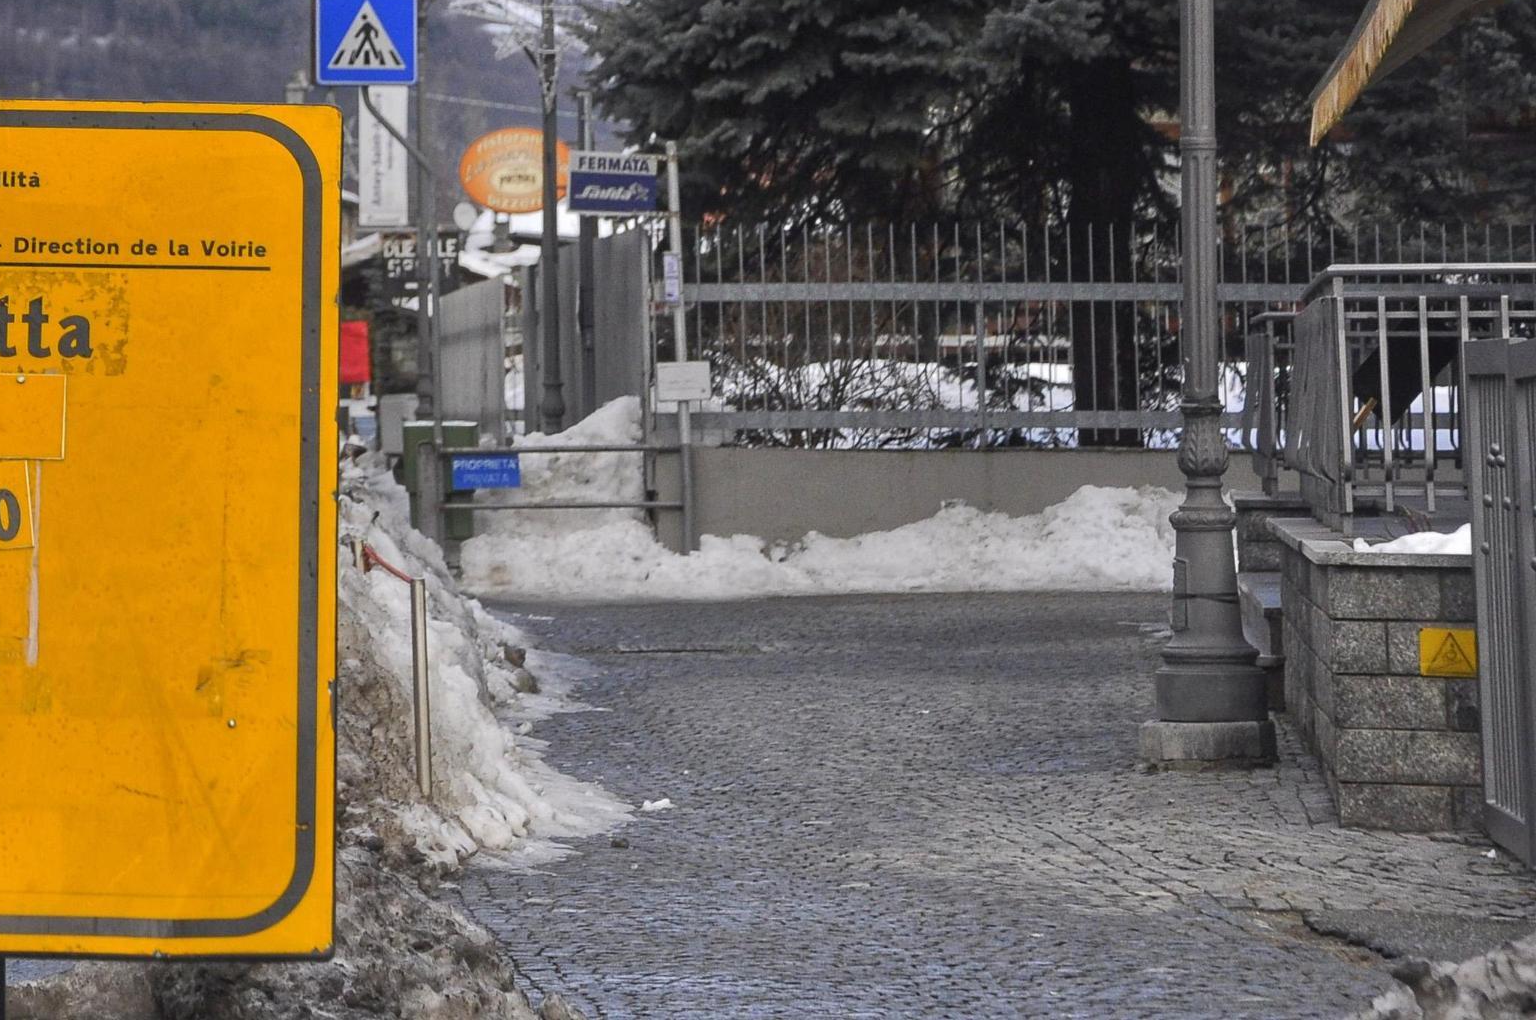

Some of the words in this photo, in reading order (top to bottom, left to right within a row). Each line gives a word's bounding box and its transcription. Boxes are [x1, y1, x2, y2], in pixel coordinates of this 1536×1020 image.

[578, 156, 651, 173] FERMATA
[15, 237, 119, 254] Direction
[131, 240, 157, 255] de
[169, 240, 189, 256] la
[202, 241, 266, 257] Voirie
